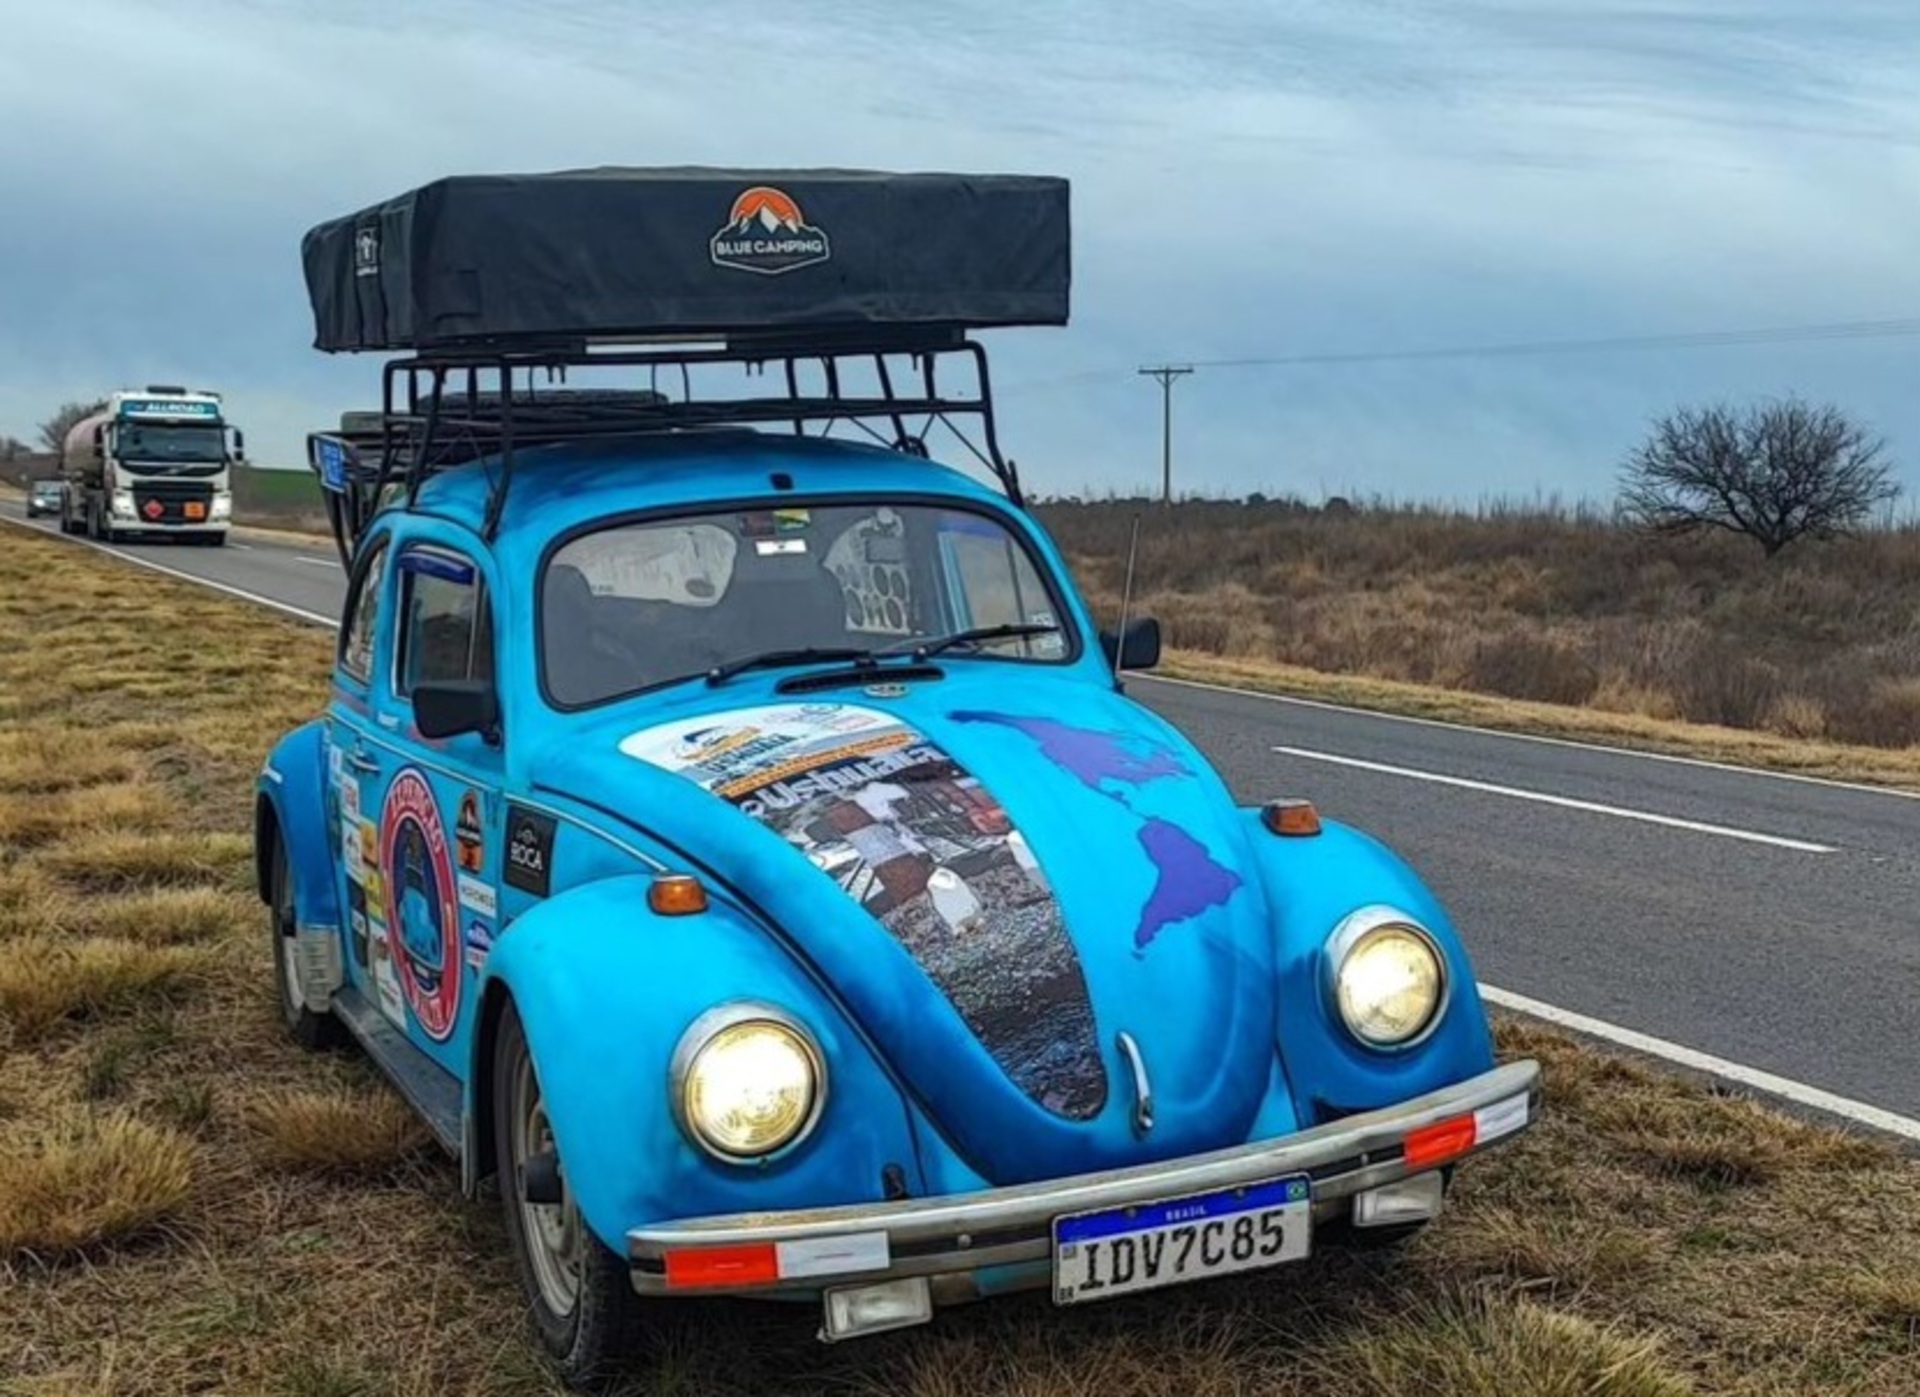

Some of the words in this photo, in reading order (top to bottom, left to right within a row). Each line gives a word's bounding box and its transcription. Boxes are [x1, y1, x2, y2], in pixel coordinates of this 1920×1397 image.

[716, 240, 752, 255] BLUE
[754, 240, 822, 254] CAMPING
[1165, 1205, 1207, 1222] BRASIL
[1079, 1209, 1285, 1291] IDV7C85
